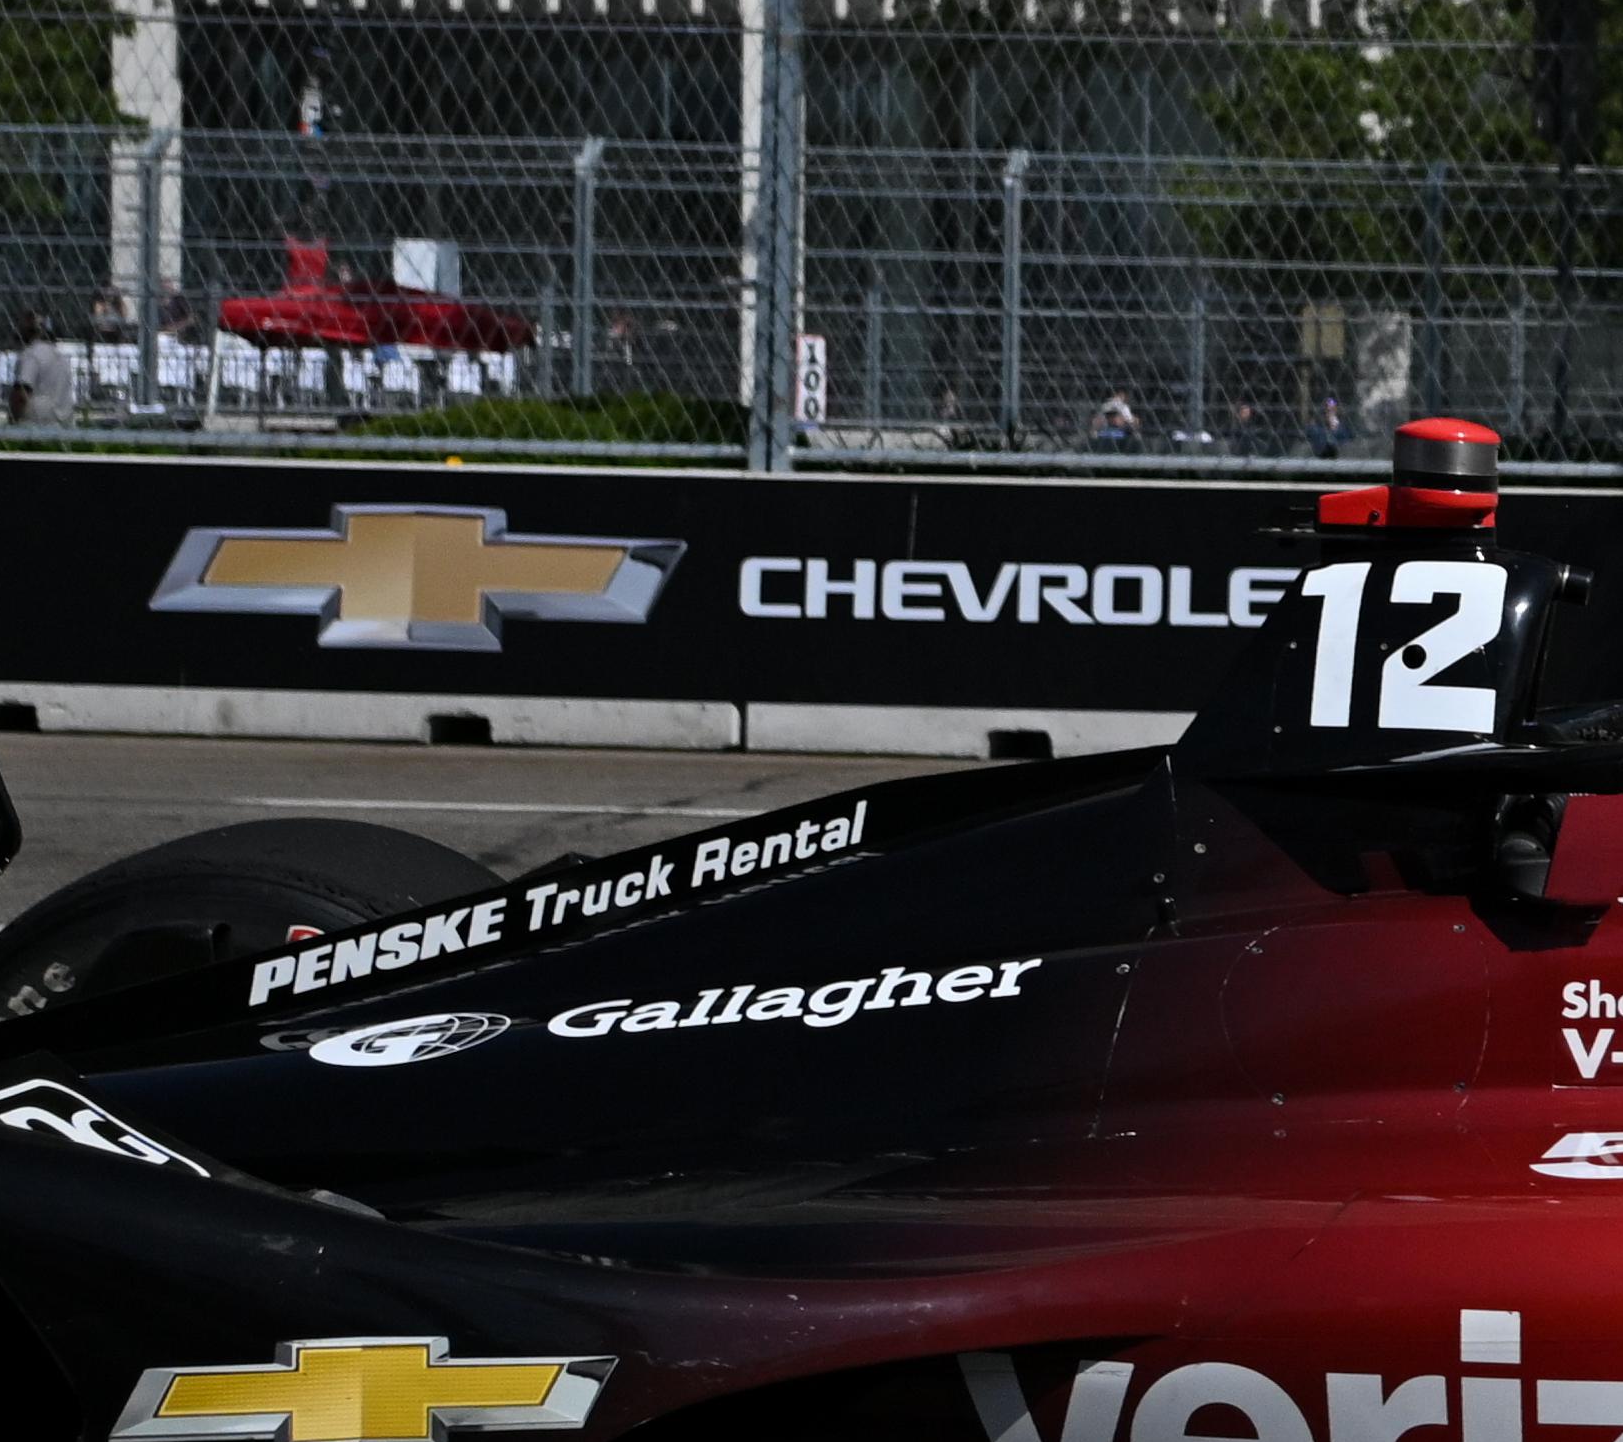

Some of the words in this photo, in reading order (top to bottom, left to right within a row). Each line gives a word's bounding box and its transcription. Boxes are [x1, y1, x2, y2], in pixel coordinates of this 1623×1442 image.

[738, 554, 1302, 629] CHEVROLE
[1301, 560, 1509, 735] 12
[249, 898, 508, 1007] PENSKE
[525, 854, 675, 934] Truck
[690, 800, 869, 889] Rental
[547, 956, 1042, 1040] Gallagher
